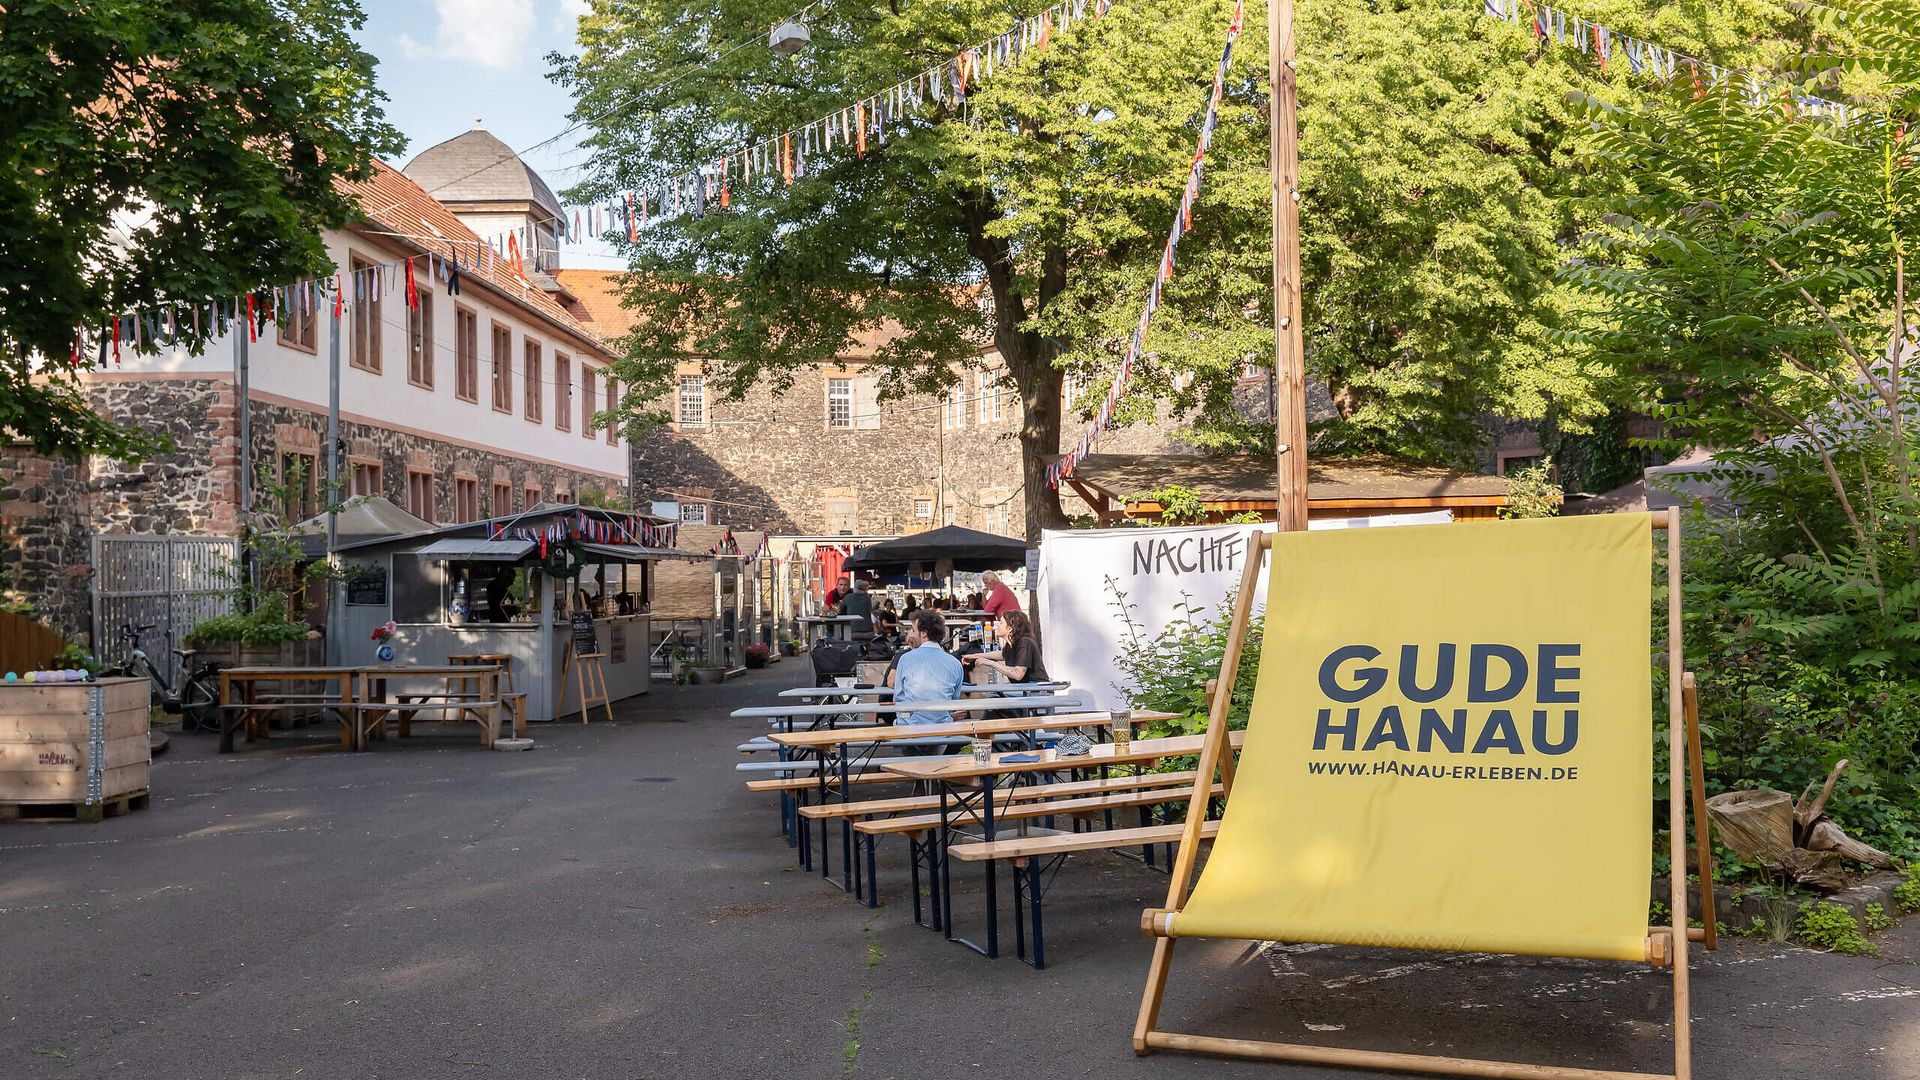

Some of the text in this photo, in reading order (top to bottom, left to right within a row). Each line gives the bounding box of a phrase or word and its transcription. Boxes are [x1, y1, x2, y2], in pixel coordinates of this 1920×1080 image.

[1132, 531, 1251, 576] NACHTF
[1318, 642, 1581, 703] GUDE
[1312, 706, 1579, 756] HANAU
[1308, 761, 1578, 780] WWW.HANAU-ERLEBEN.DE
